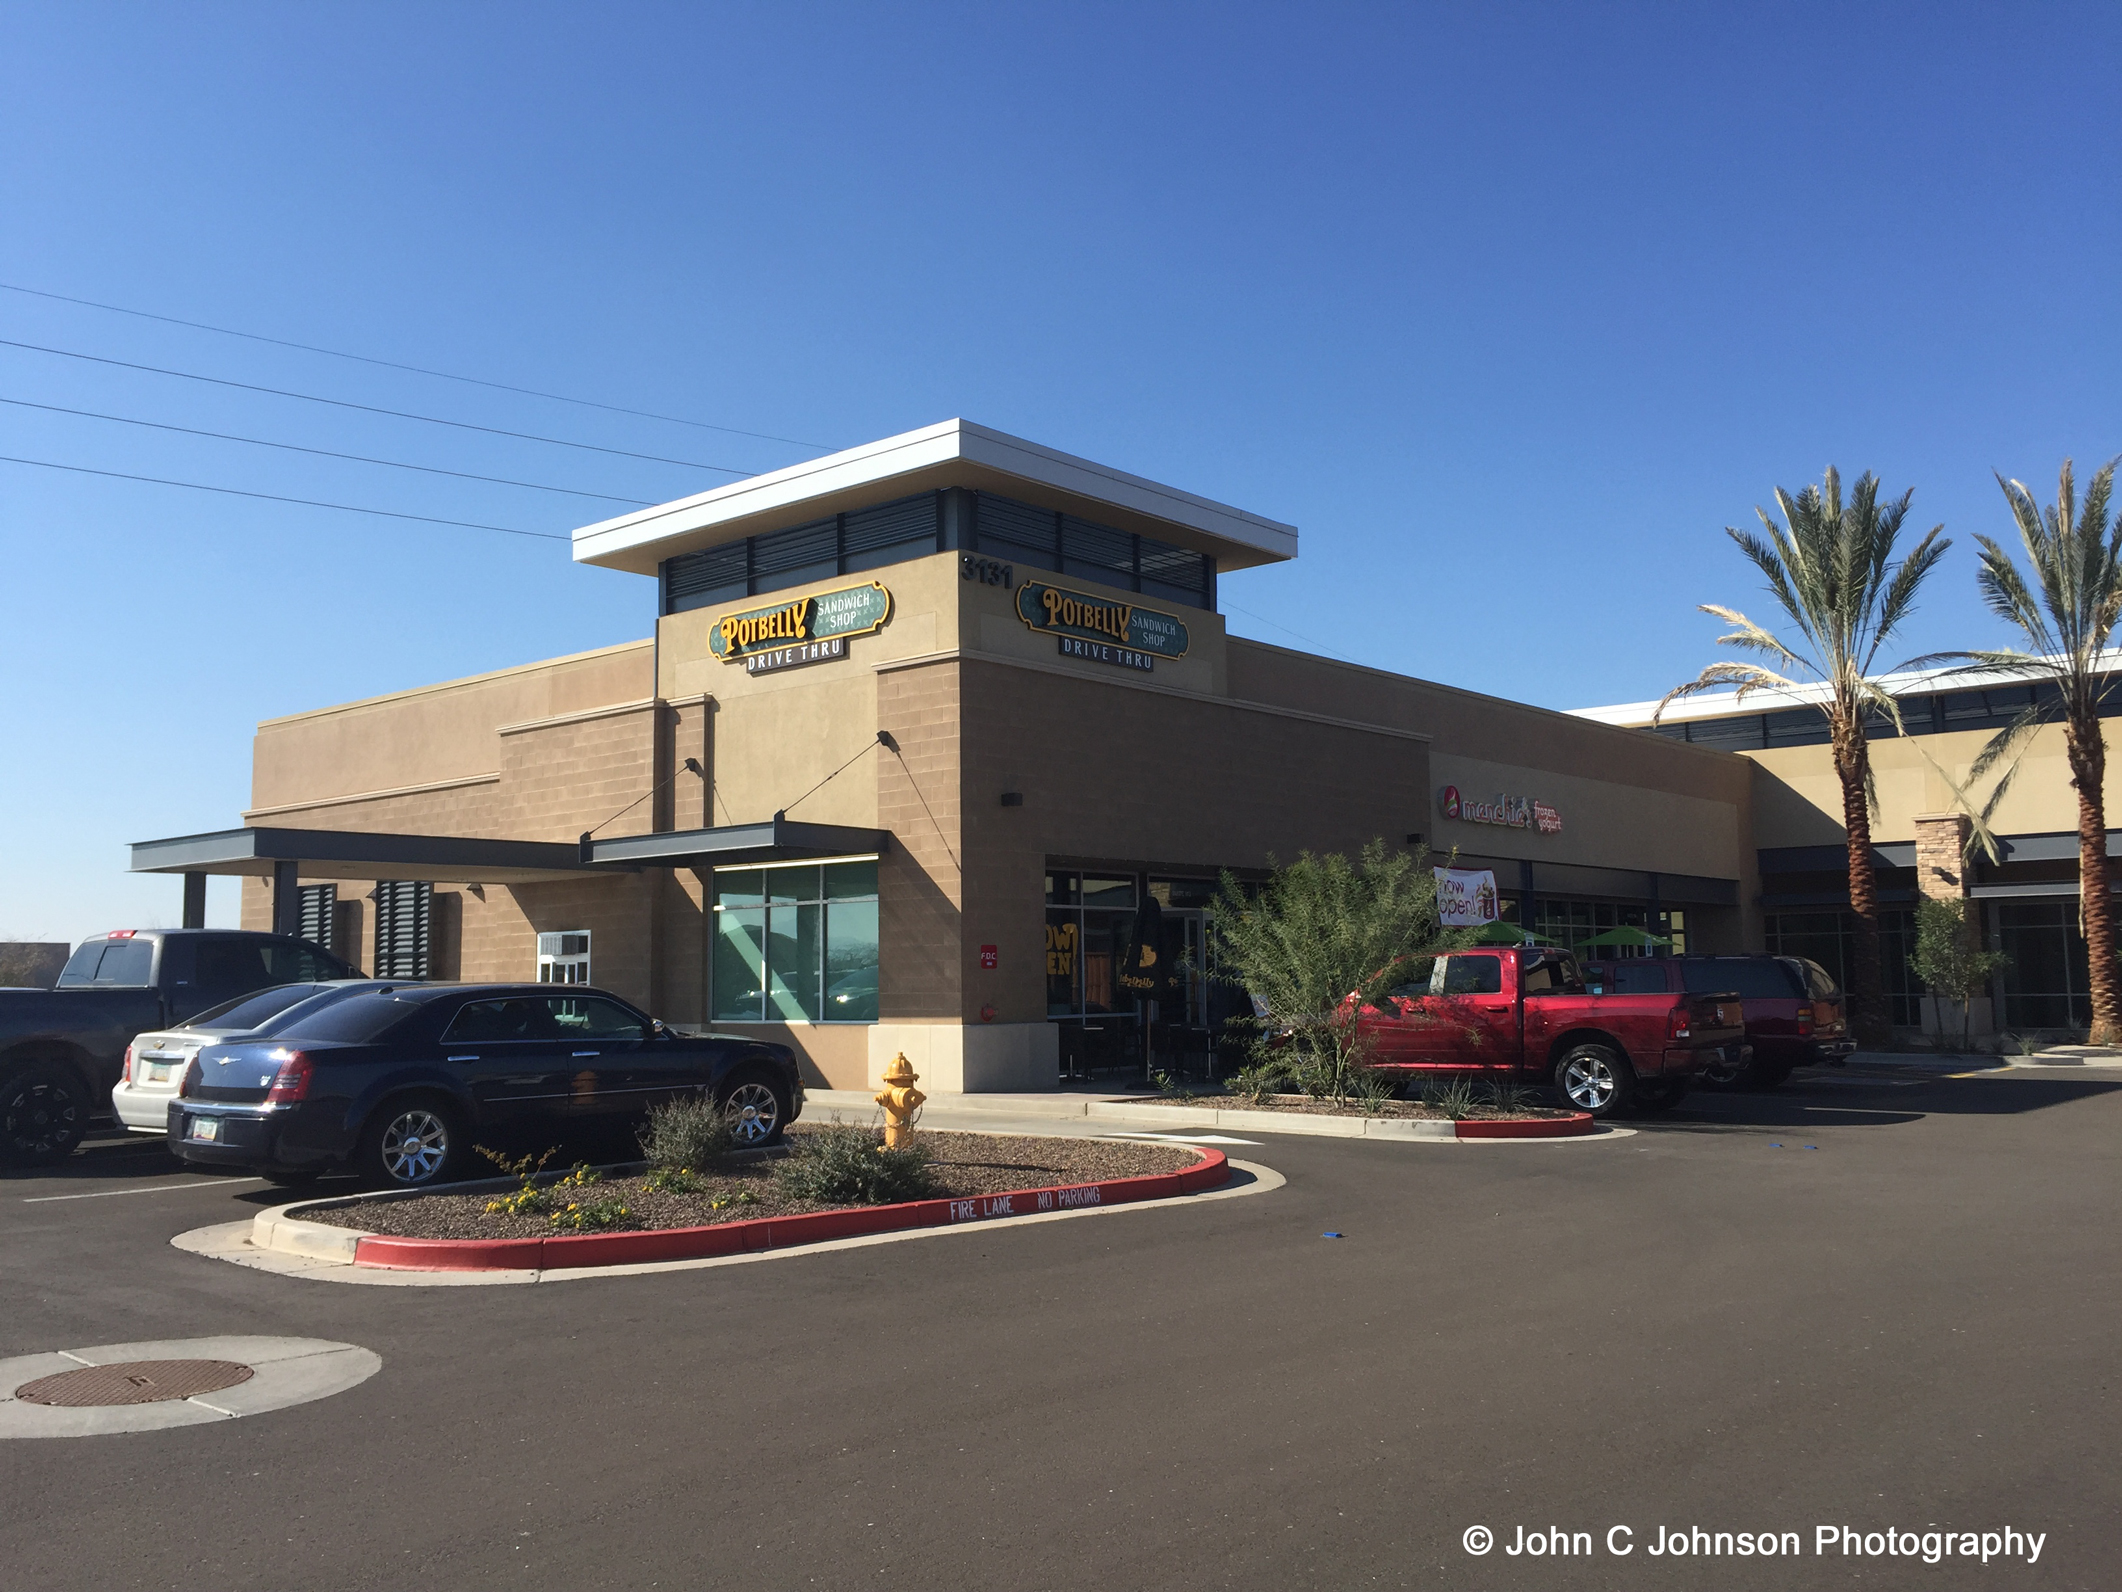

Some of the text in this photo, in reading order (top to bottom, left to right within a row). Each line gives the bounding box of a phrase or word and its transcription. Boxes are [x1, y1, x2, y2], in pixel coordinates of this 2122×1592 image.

[961, 555, 1013, 589] 3131
[818, 593, 870, 616] SANDWICH
[1042, 588, 1132, 642] POTBELLY
[720, 598, 809, 654] POTBELLY
[829, 612, 857, 628] SHOP
[1131, 615, 1176, 636] SANDWICH
[1142, 631, 1166, 647] SHOP
[748, 639, 840, 670] DRIVE THRU
[1064, 638, 1151, 669] DRIVE THRU
[1462, 793, 1532, 829] menchie's
[1534, 801, 1557, 819] frozen
[1538, 816, 1562, 832] yogurt
[1439, 896, 1476, 918] open!
[950, 1186, 1100, 1220] FIRE LANE NO PARKING
